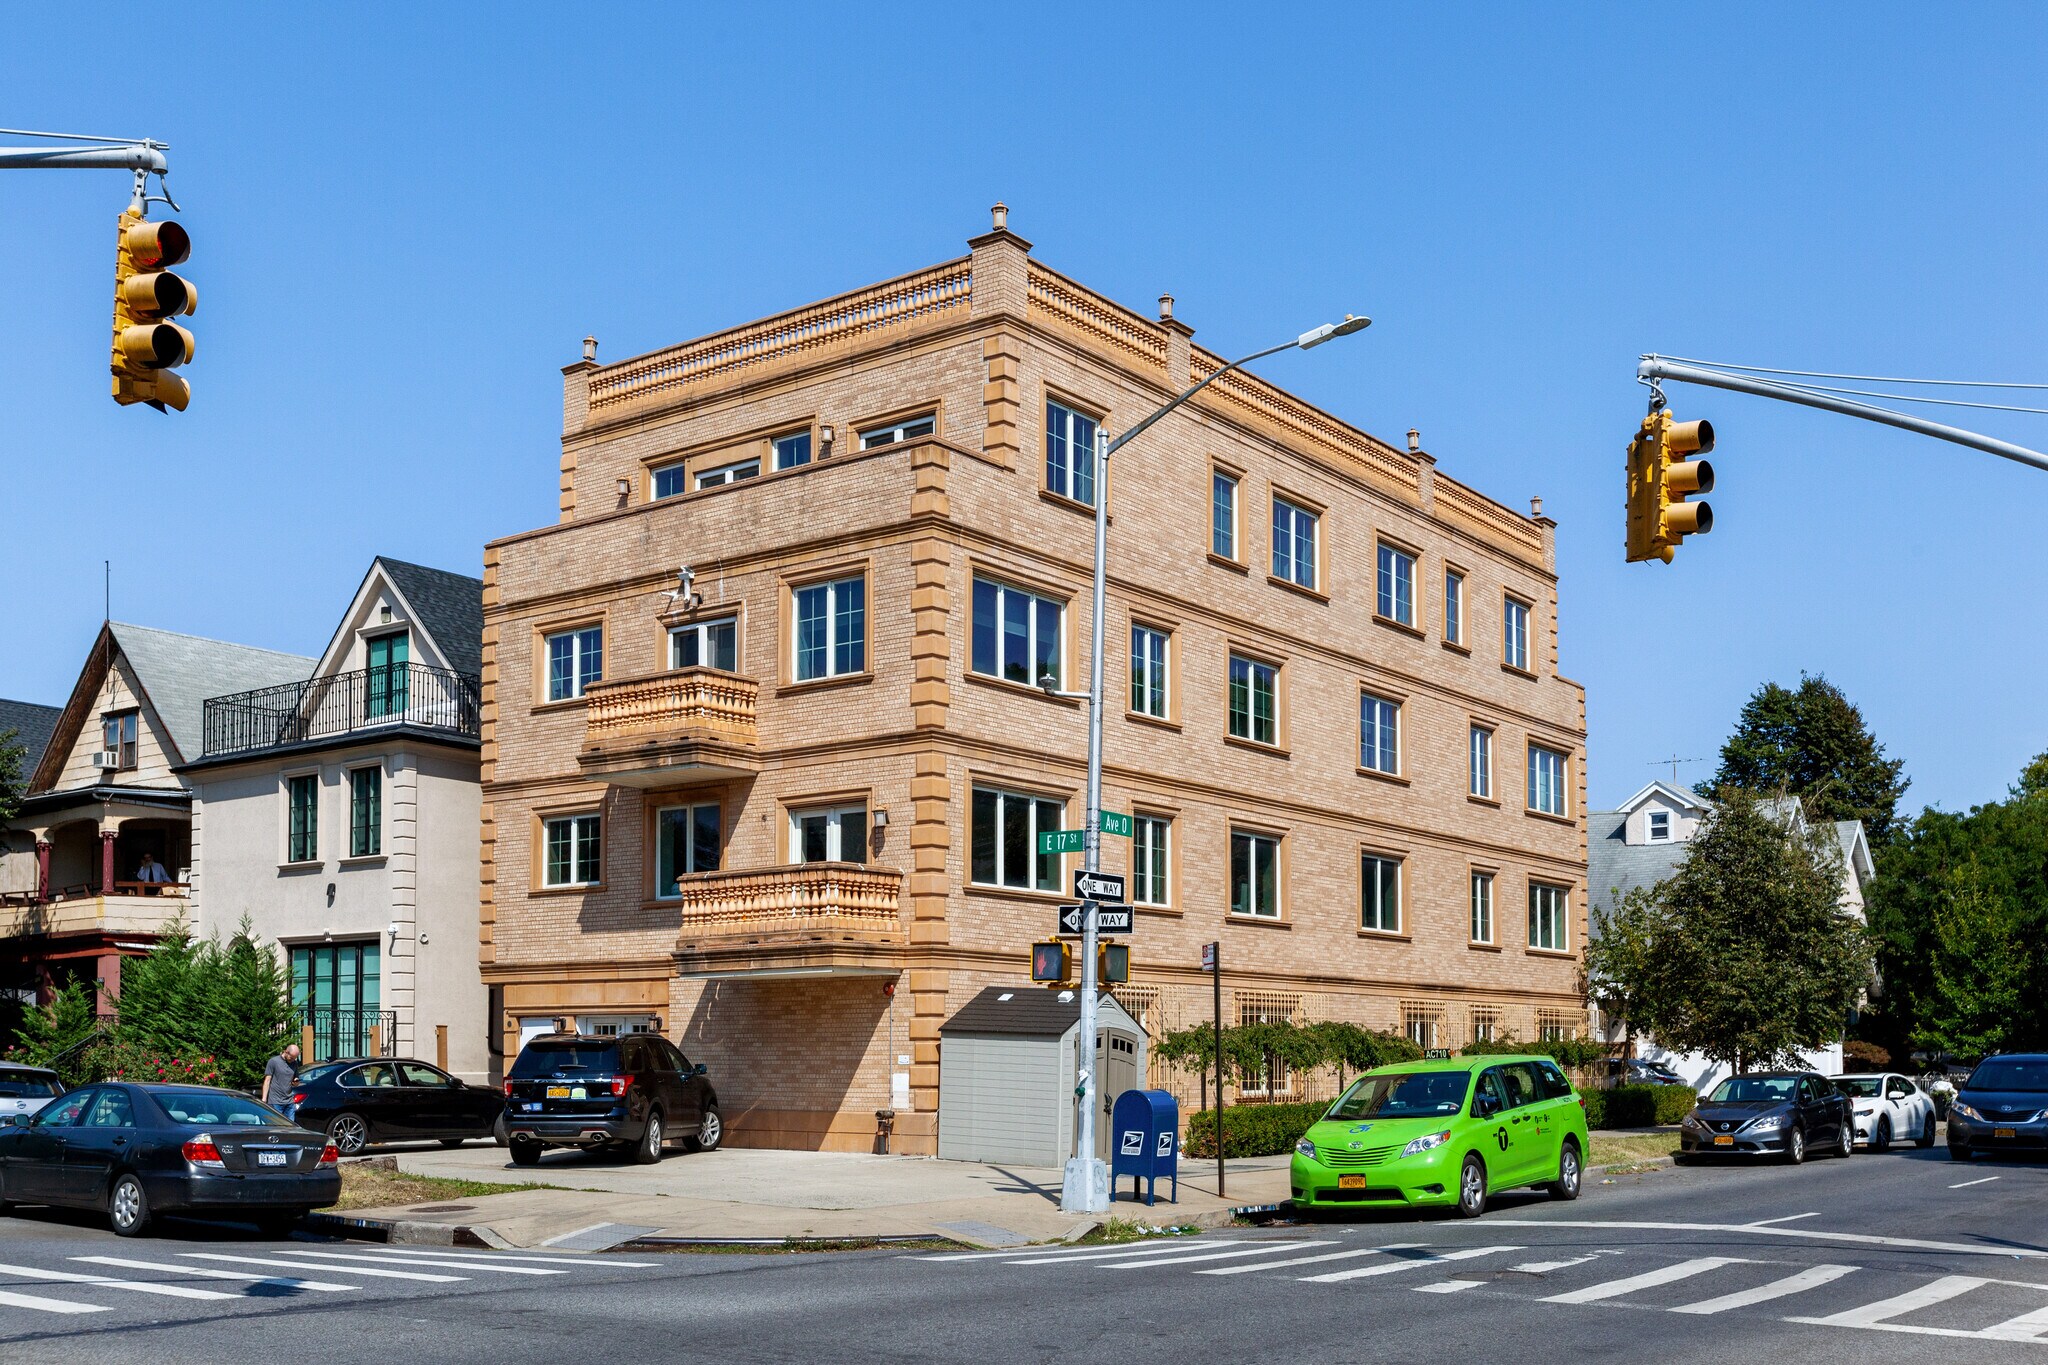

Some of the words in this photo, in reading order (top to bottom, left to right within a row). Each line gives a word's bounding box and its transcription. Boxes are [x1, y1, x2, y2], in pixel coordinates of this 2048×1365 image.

[1106, 815, 1119, 832] Ave
[1047, 836, 1053, 850] E
[1057, 834, 1067, 850] 17
[1070, 833, 1077, 843] St
[1082, 879, 1097, 892] ONE
[1103, 882, 1119, 895] WAY
[1070, 914, 1084, 926] ON
[1101, 914, 1124, 925] WAY
[1426, 1049, 1447, 1059] AC710
